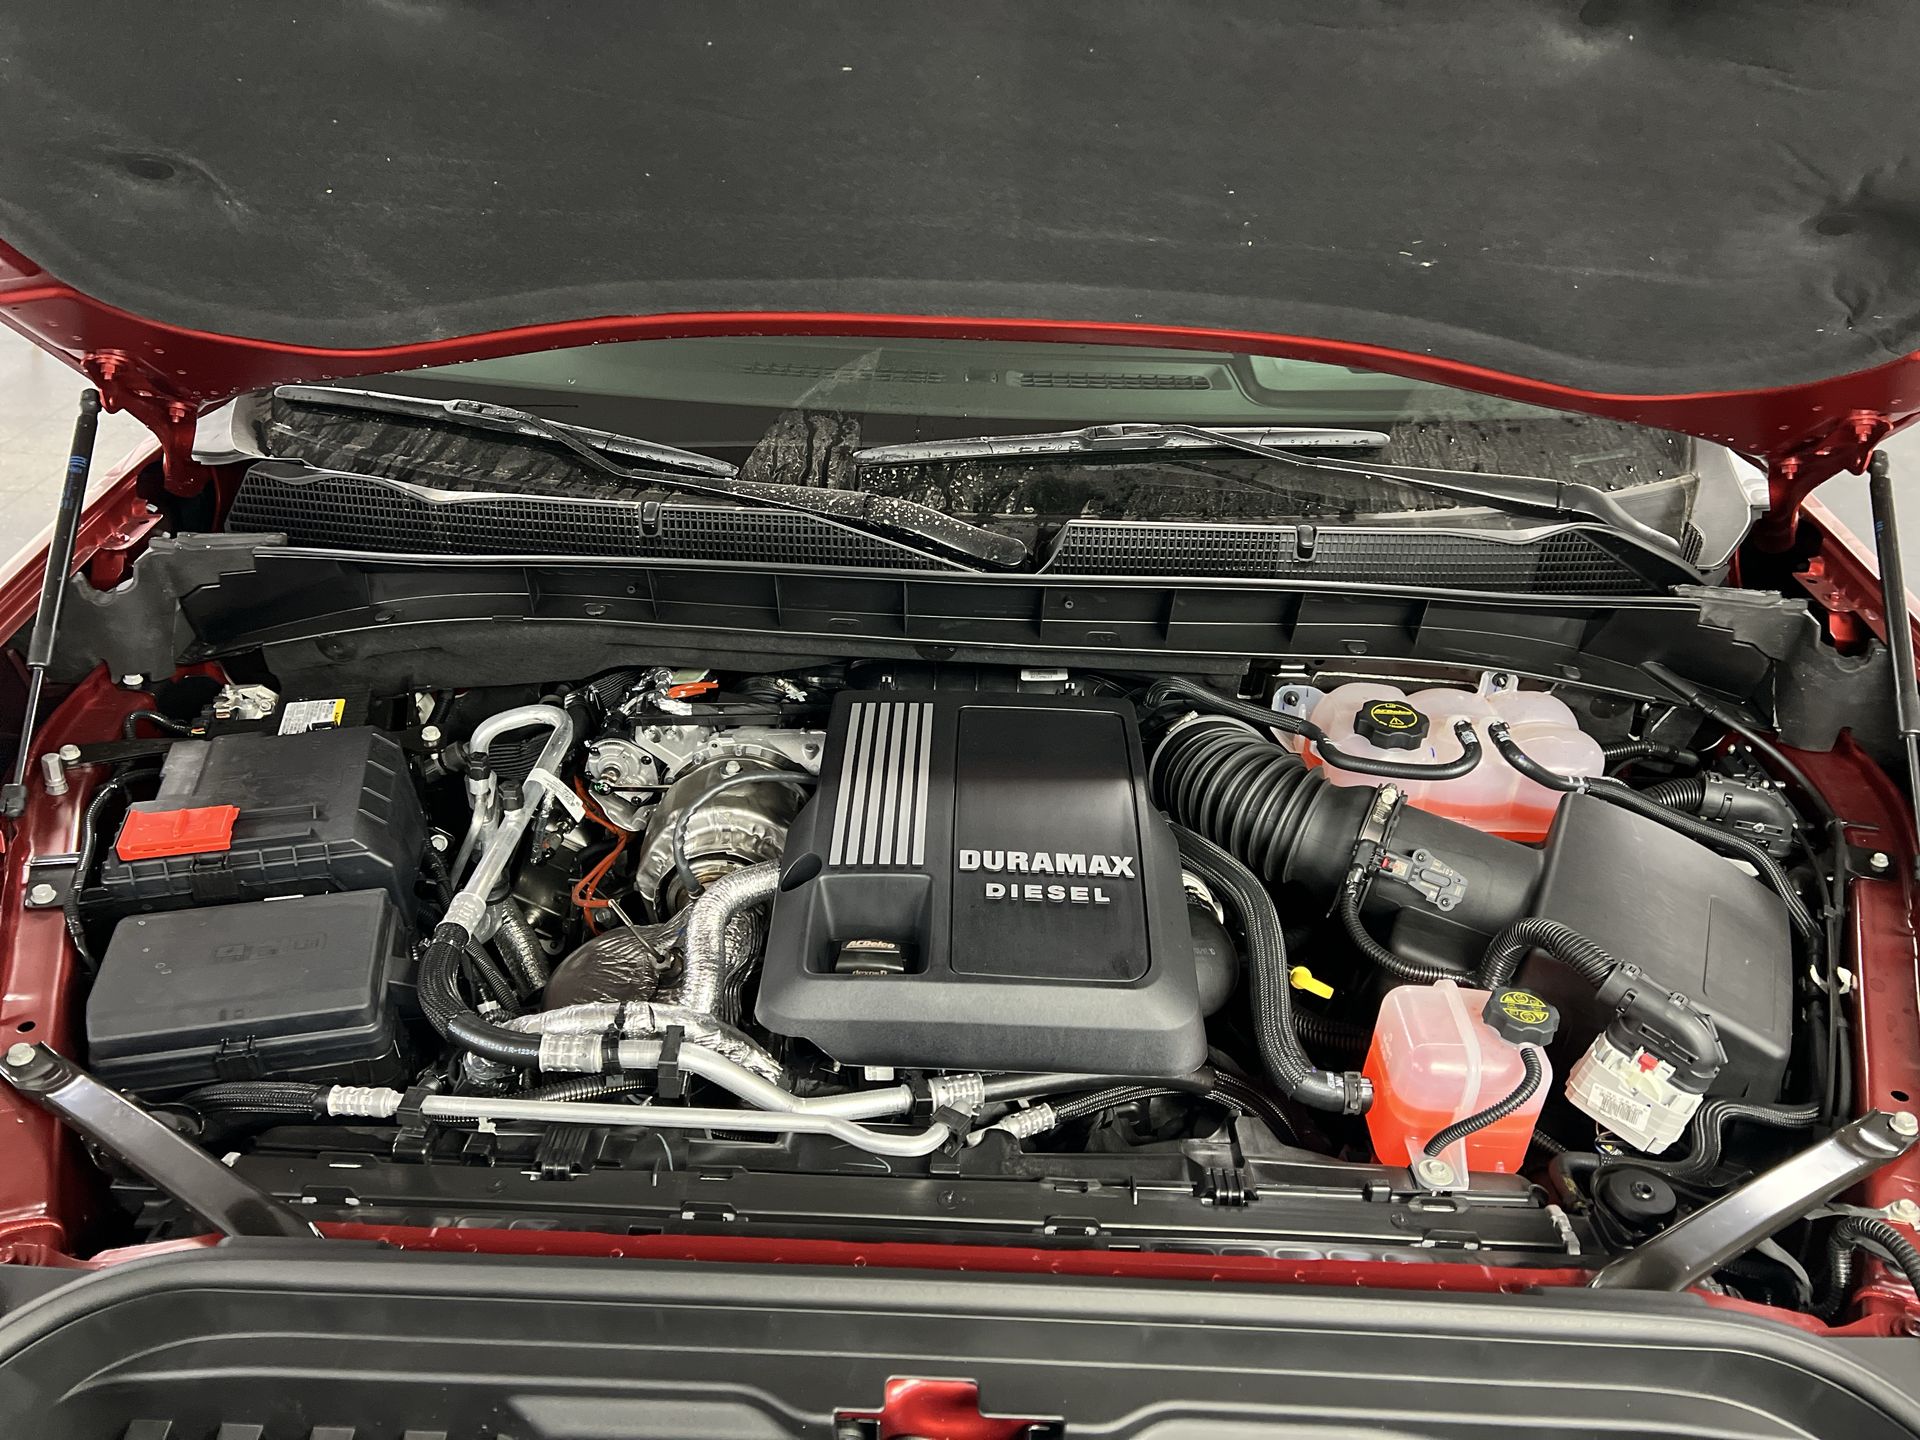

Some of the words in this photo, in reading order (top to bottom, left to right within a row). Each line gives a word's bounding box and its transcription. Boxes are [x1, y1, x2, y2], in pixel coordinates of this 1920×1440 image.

[959, 849, 1136, 879] DURAMAX
[985, 882, 1111, 905] DIESEL
[846, 940, 896, 949] ACDelco
